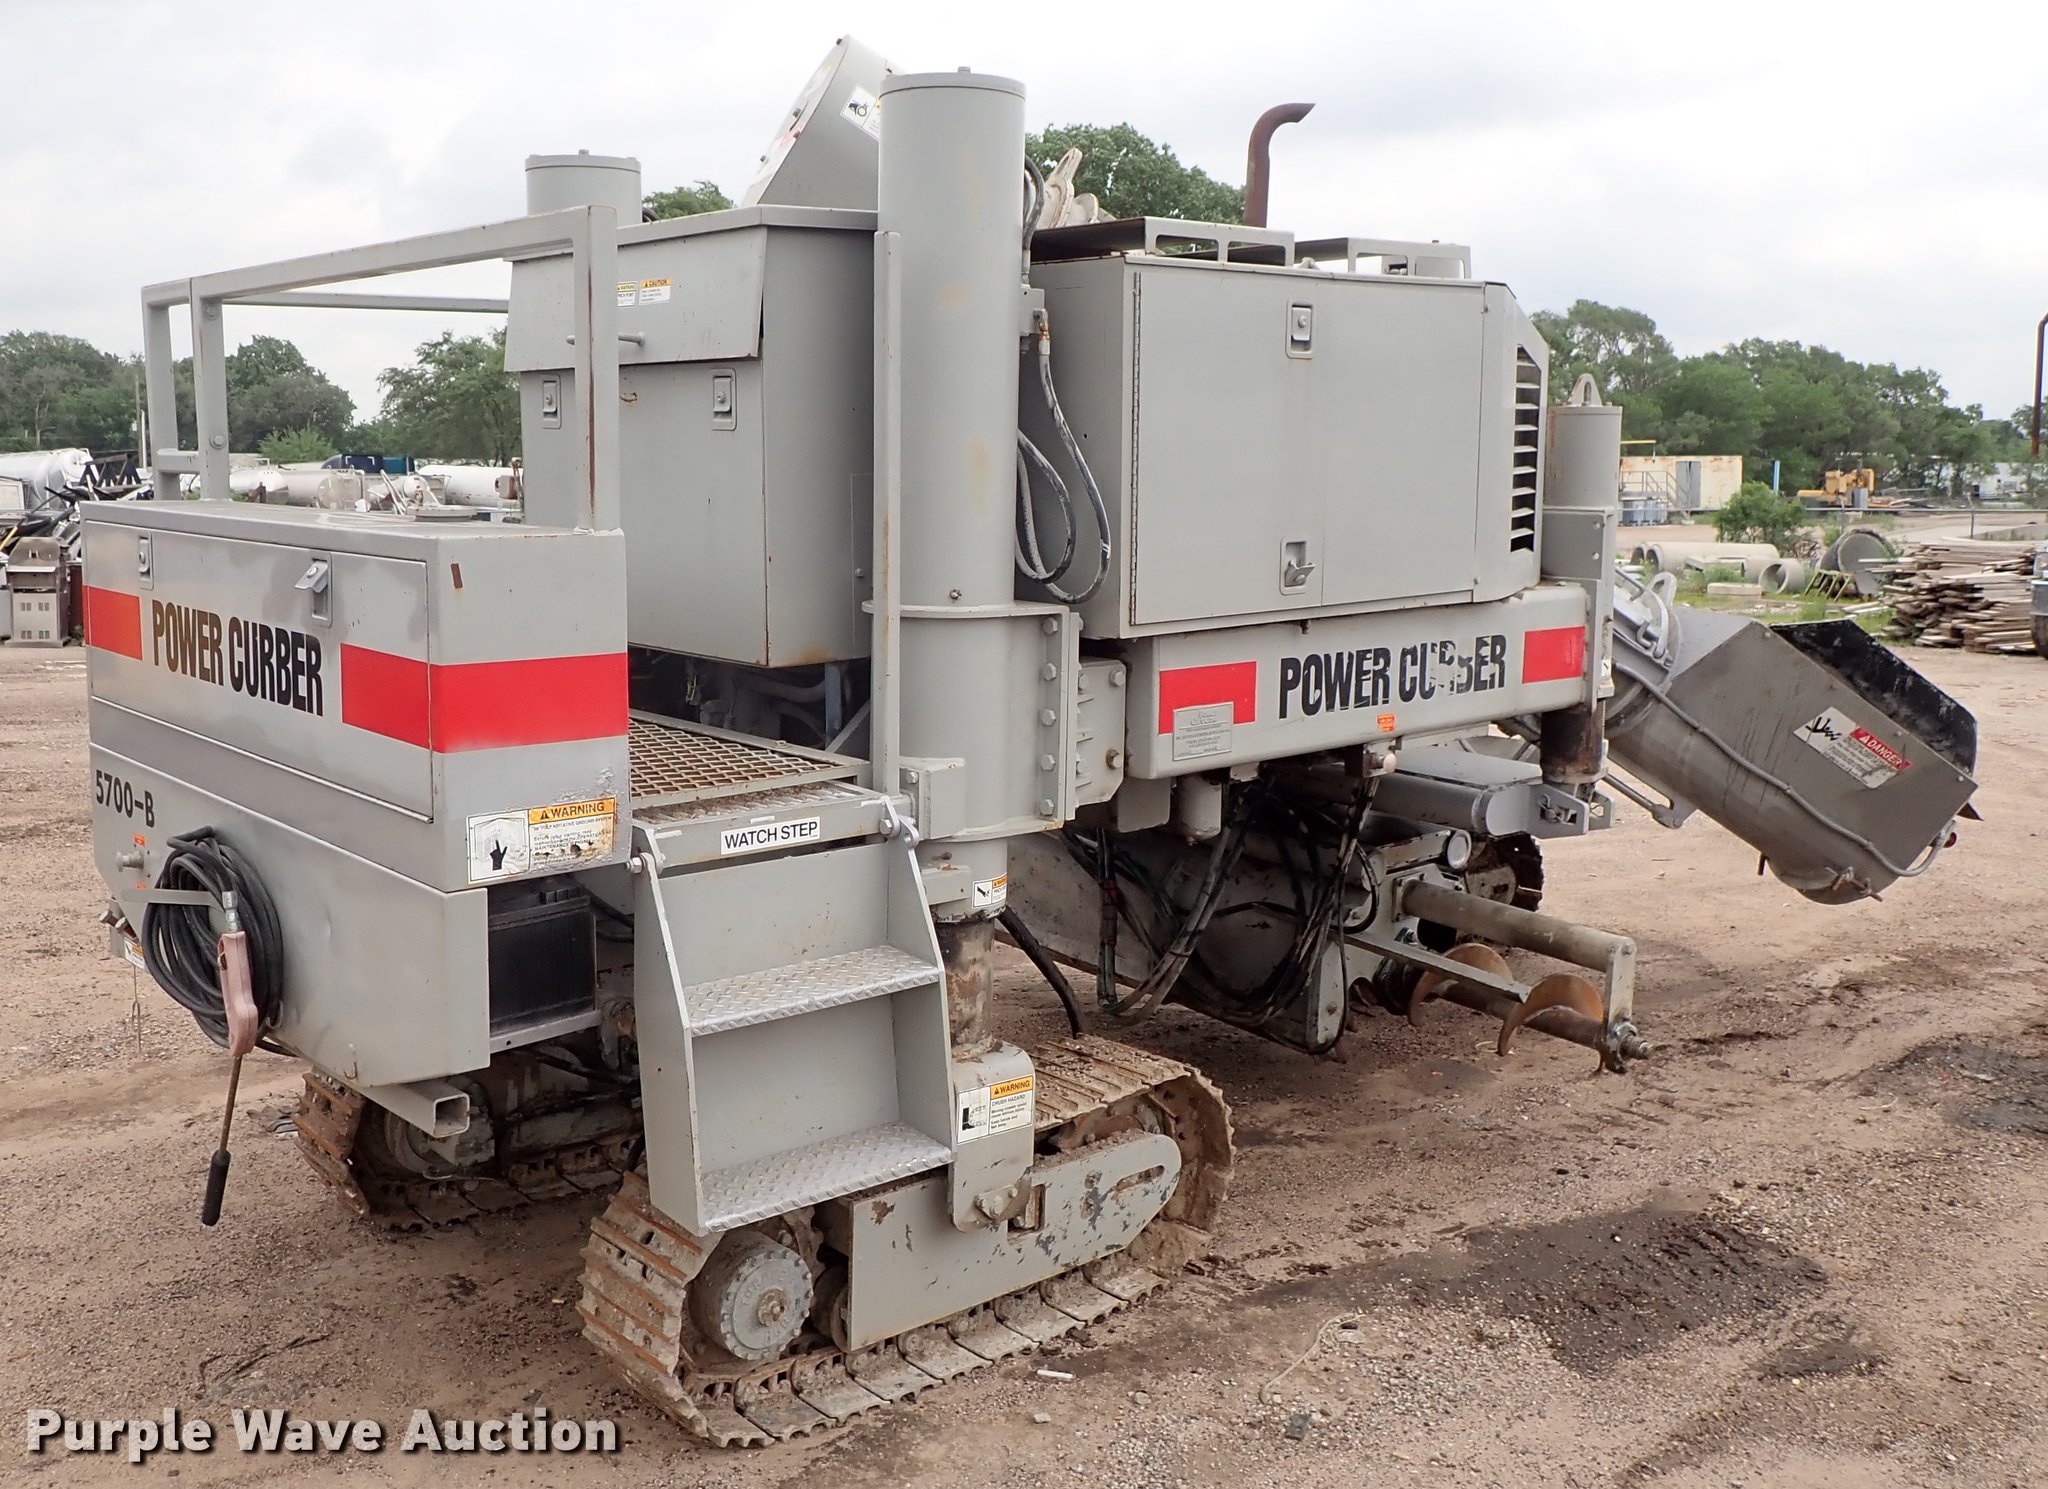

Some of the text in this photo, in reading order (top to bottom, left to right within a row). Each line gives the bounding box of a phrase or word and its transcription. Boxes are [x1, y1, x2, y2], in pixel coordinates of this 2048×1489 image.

[152, 599, 324, 717] POWER CURBER
[1278, 646, 1391, 720] POWER
[96, 769, 155, 828] 5700-B
[551, 802, 605, 818] WARNING
[724, 821, 818, 849] WATCH STEP
[992, 1094, 1025, 1107] CRUSH HAZARD
[1000, 1080, 1031, 1094] WARNING
